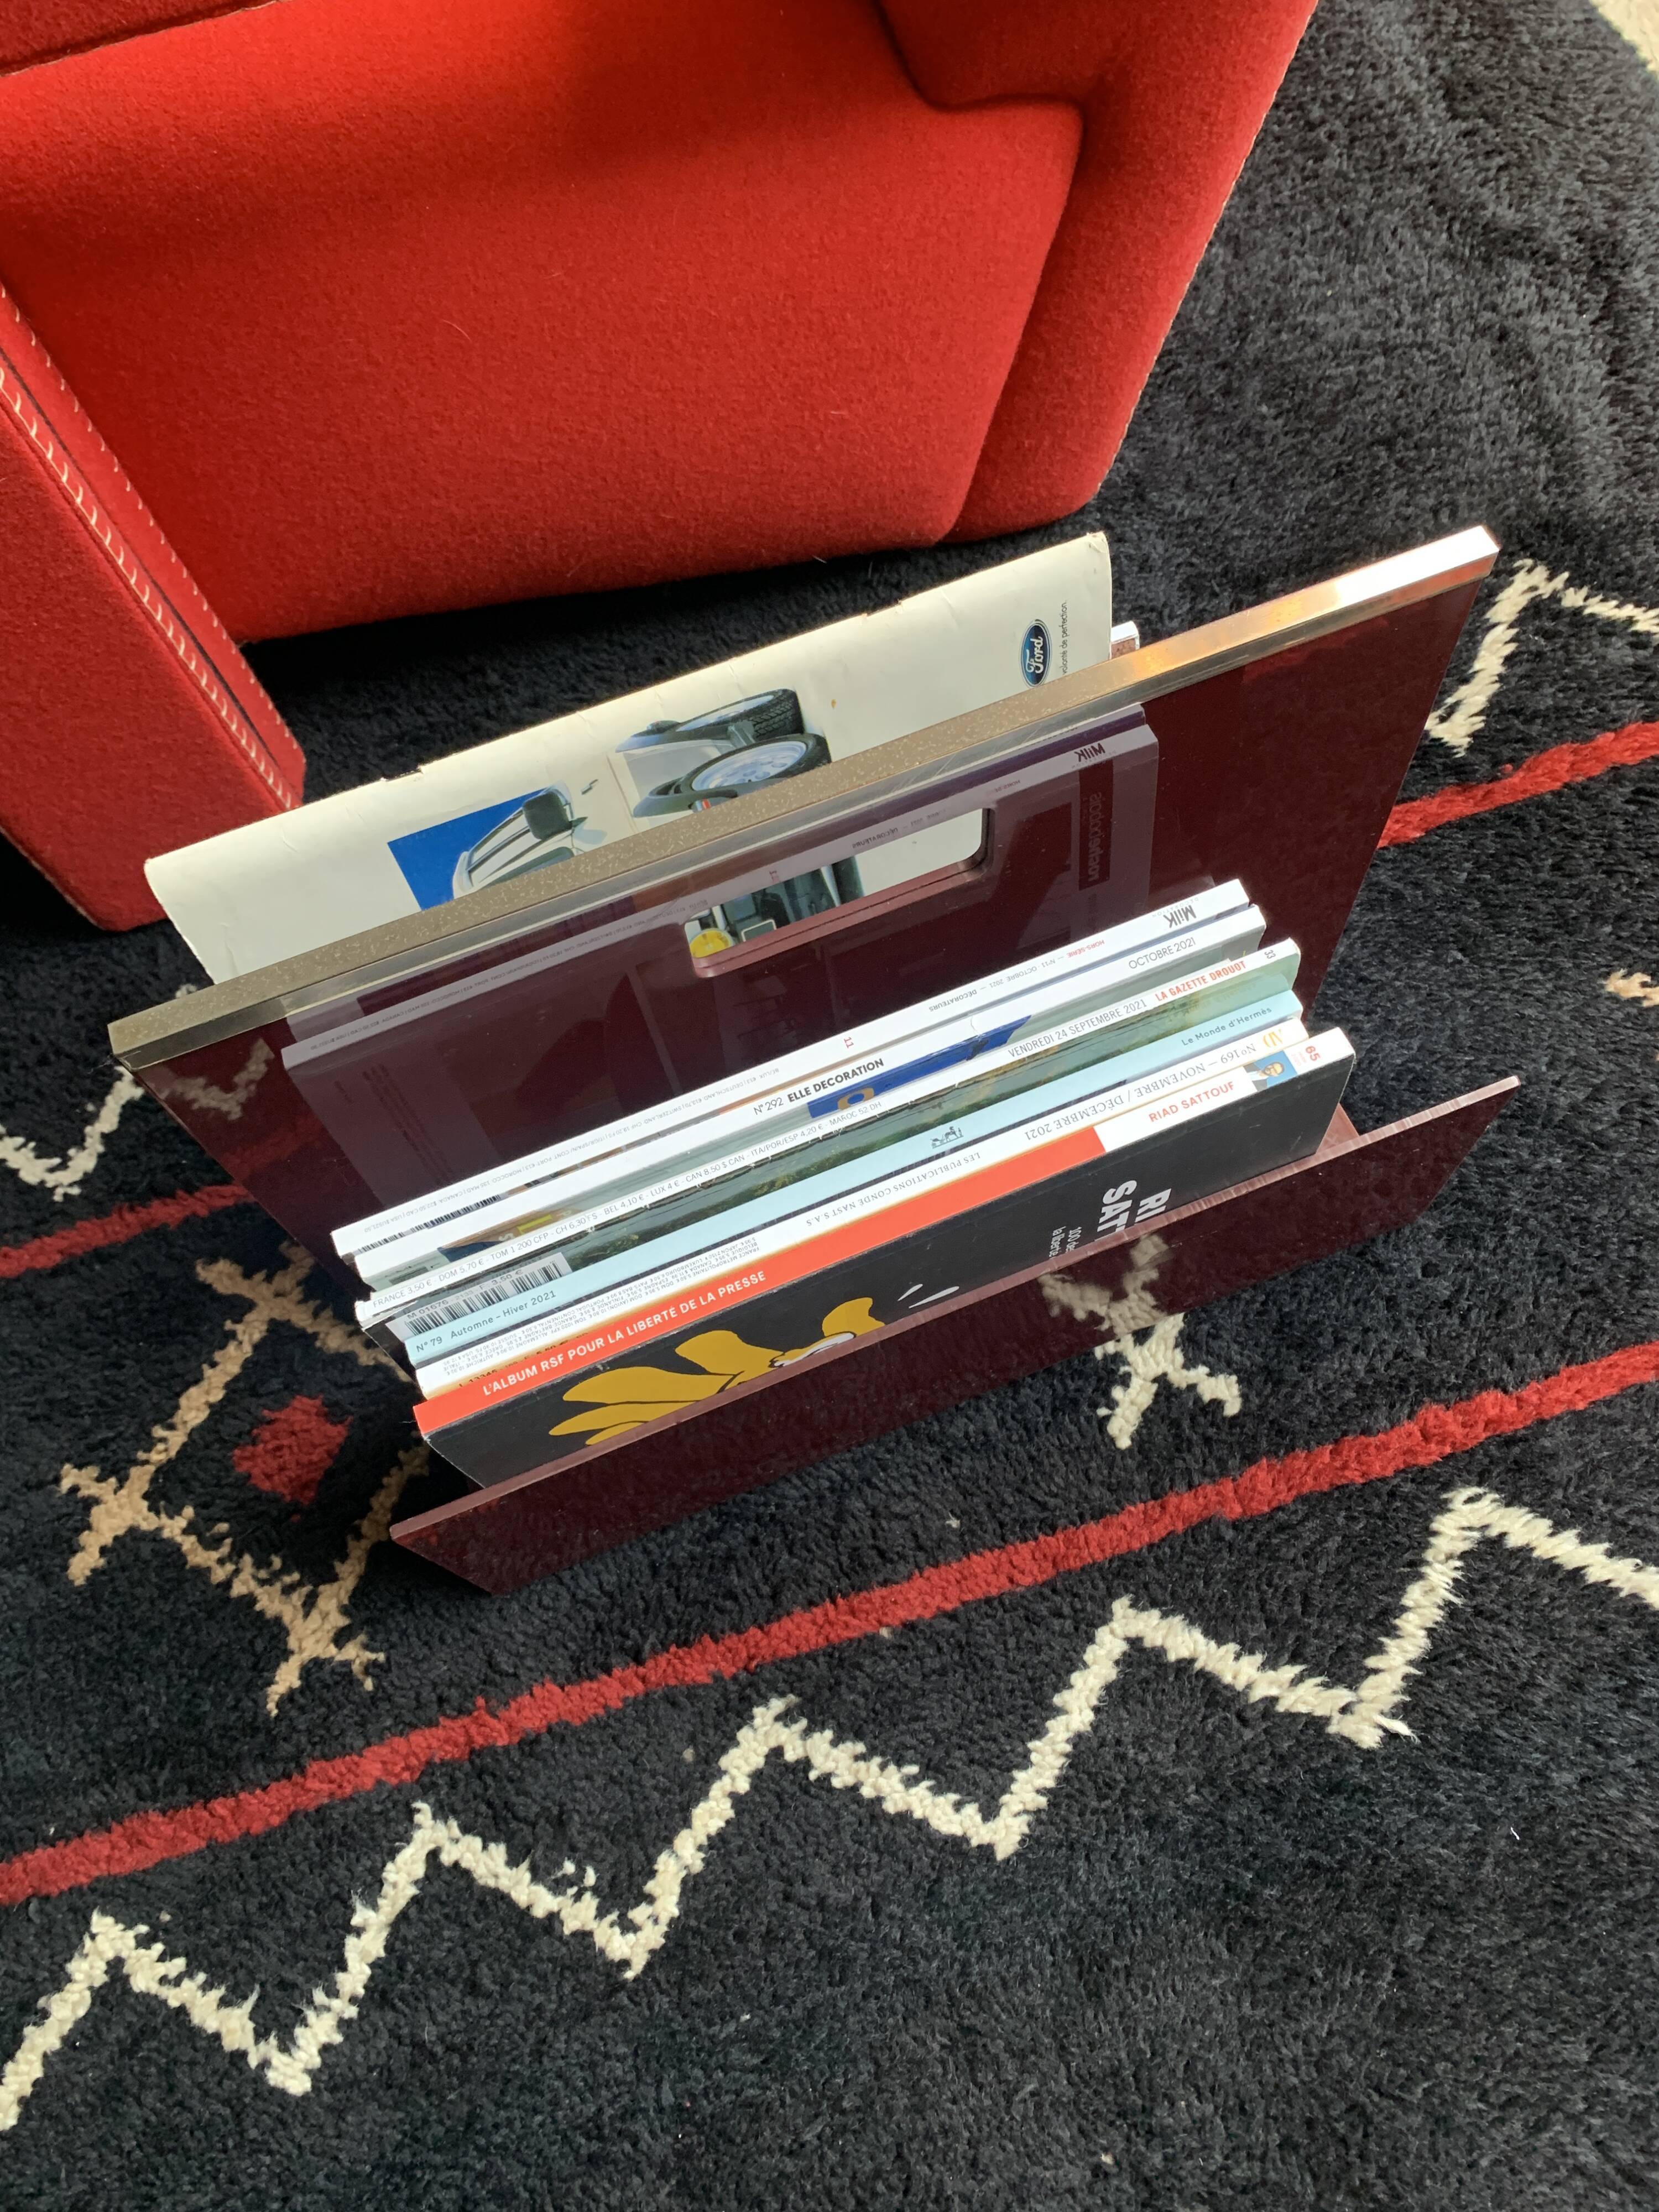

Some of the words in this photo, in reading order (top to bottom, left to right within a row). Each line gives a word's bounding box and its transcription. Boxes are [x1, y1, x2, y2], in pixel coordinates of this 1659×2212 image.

[1026, 636, 1044, 674] Ford
[1059, 640, 1067, 649] de
[1163, 905, 1197, 928] MilK
[1066, 940, 1104, 958] HORS-SÉRIE
[1129, 946, 1174, 969] OCTOBRE
[1173, 937, 1196, 952] 2021
[989, 979, 1004, 988] 2021
[1006, 966, 1037, 982] OCTOBRE
[929, 989, 977, 1011] DÉCORATEURS
[1008, 1034, 1054, 1057] VENDREDI
[1055, 1029, 1067, 1040] 24
[1069, 1008, 1123, 1035] SEPTEMBRE
[1123, 999, 1147, 1014] 2021
[1155, 992, 1168, 1001] LA
[1168, 975, 1208, 996] GAZETTE
[1209, 961, 1246, 980] DROUOT
[1264, 950, 1276, 959] 33
[844, 1037, 854, 1048] 11
[1195, 1026, 1226, 1040] Monde
[1306, 1046, 1321, 1061] 65
[787, 1087, 811, 1102] ELLE
[813, 1058, 884, 1092] DECORATION
[1134, 1063, 1206, 1097] NOVEMBRE
[1053, 1095, 1124, 1129] DÉCEMBRE
[1149, 1105, 1178, 1122] RIAD
[1181, 1081, 1233, 1109] SATTOUF
[1025, 1124, 1052, 1140] 2021
[963, 1152, 980, 1164] LES
[893, 1160, 962, 1191] PUBLICATIONS
[373, 1290, 406, 1307] FRANCE
[408, 1282, 425, 1294] 3,50
[439, 1269, 457, 1281] DOM
[460, 1261, 477, 1273] 5,70
[491, 1249, 508, 1260] TOM
[534, 1233, 548, 1243] CFP
[556, 1225, 567, 1234] CH
[569, 1218, 586, 1229] 6,30
[604, 1205, 619, 1215] BEL
[620, 1197, 637, 1207] 4,10
[650, 1186, 666, 1196] LUX
[686, 1171, 702, 1182] CAN
[703, 1164, 721, 1175] 8,50
[728, 1155, 745, 1165] CAN
[751, 1134, 798, 1156] ITA/POR/ESP
[801, 1126, 816, 1136] 4,20
[830, 1111, 857, 1125] MAROC
[858, 1107, 869, 1115] 52
[869, 1102, 881, 1110] DH
[858, 1188, 891, 1206] CONDÉ
[1135, 1188, 1171, 1223] RI
[832, 1202, 856, 1217] NAST
[1067, 1227, 1082, 1241] 100
[406, 1311, 418, 1320] M
[418, 1298, 450, 1316] 01676
[514, 1268, 524, 1276] €
[451, 1317, 493, 1339] Automne
[503, 1303, 528, 1317] Hiver
[531, 1290, 556, 1305] 2021
[540, 1354, 564, 1371] RSF
[567, 1338, 604, 1360] POUR
[607, 1331, 624, 1343] LA
[626, 1307, 677, 1335] LIBERTÉ
[680, 1299, 697, 1313] DE
[699, 1292, 716, 1305] LA
[718, 1271, 765, 1297] PRESSE
